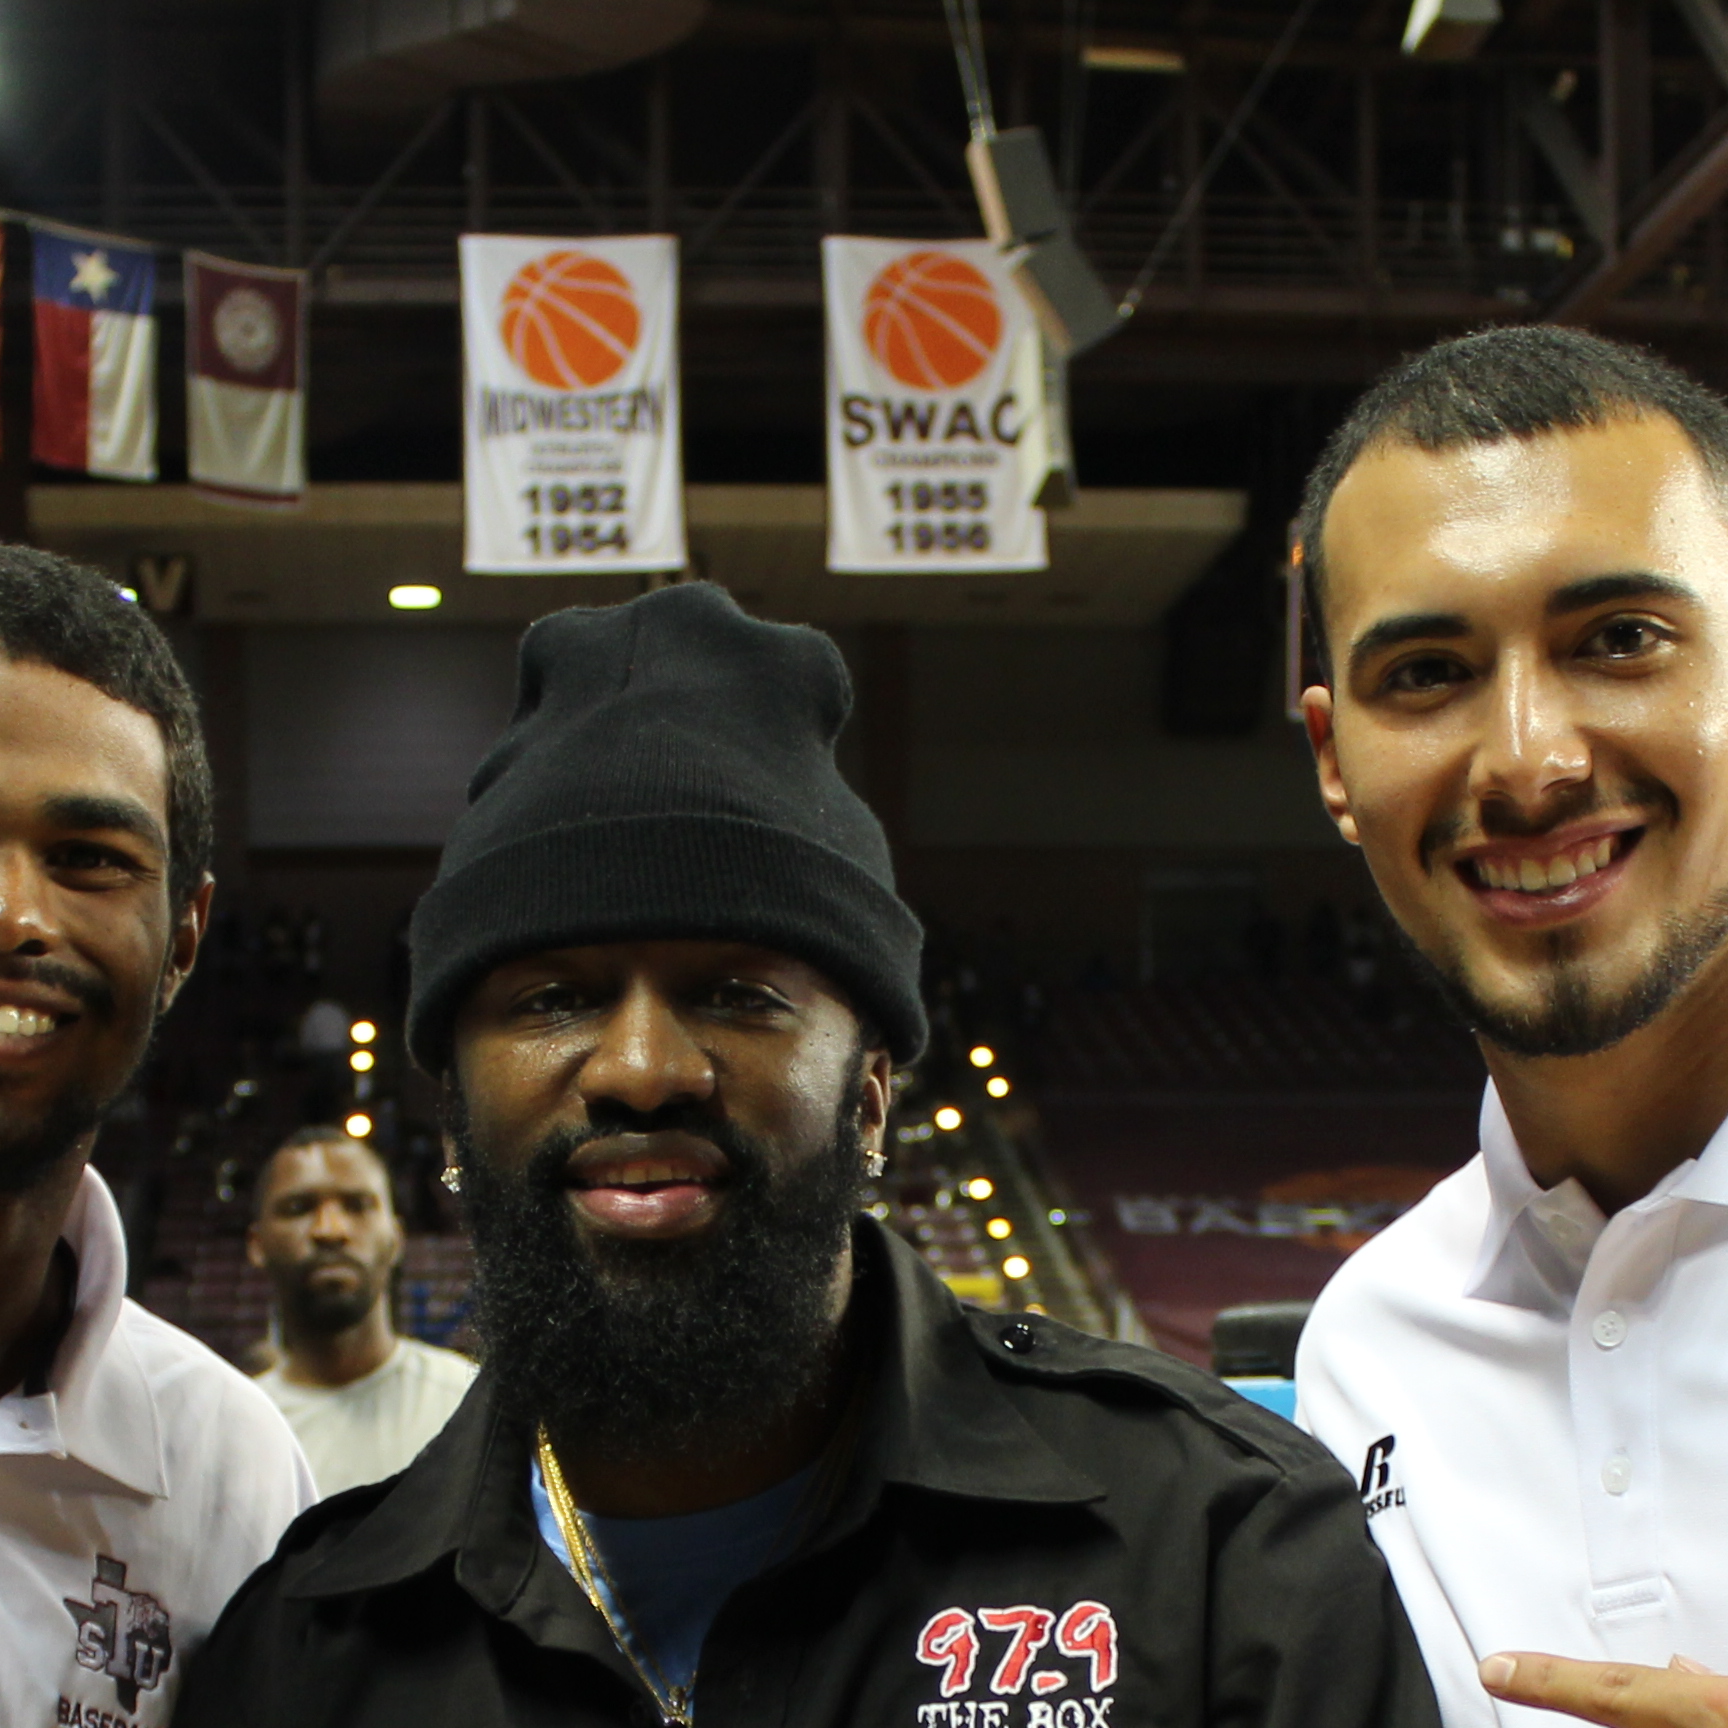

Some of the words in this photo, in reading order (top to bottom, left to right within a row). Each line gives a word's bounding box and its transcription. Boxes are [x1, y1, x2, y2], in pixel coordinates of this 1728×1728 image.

[842, 394, 1023, 447] SWAC
[523, 523, 629, 556] 1954
[916, 1600, 1118, 1697] 97.9
